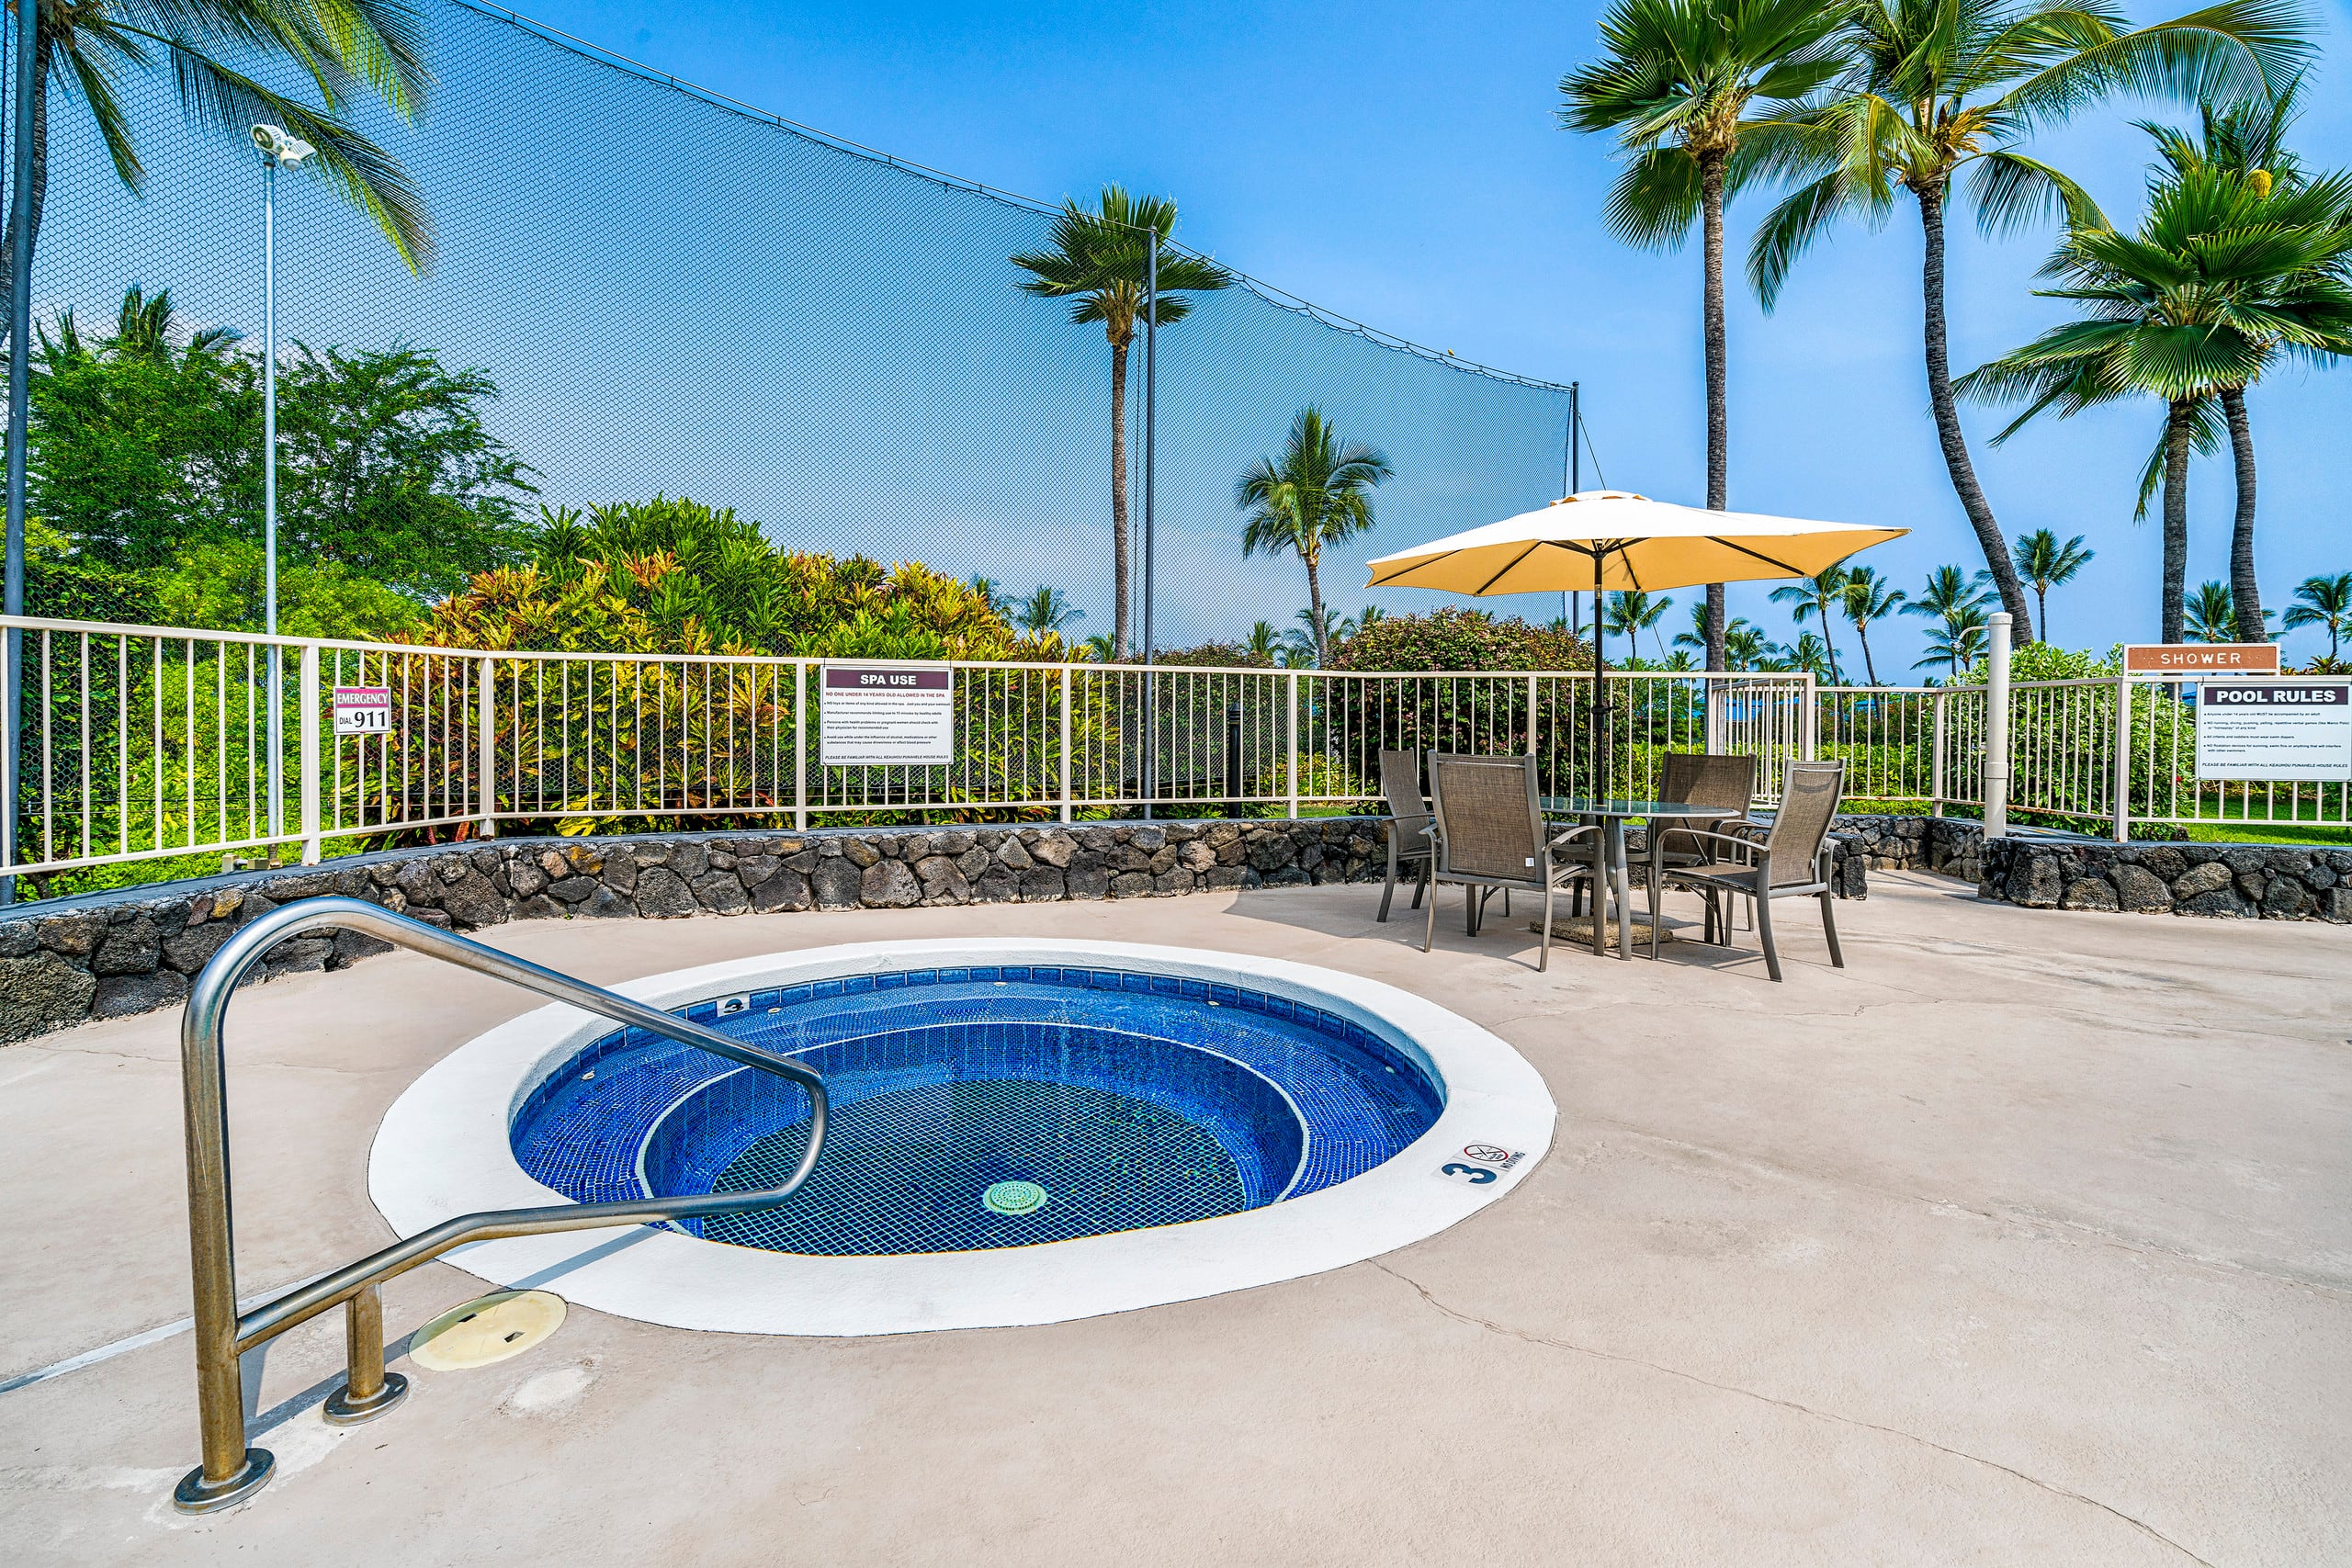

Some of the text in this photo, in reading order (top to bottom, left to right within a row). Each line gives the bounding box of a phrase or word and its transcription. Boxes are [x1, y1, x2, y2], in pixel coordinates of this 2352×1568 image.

[2161, 653, 2241, 664] SHOWER
[860, 674, 917, 685] SPA USE
[337, 694, 388, 704] EMERGENCY
[2216, 690, 2336, 703] POOL RULES
[355, 711, 385, 728] 911
[1442, 1163, 1497, 1184] 3
